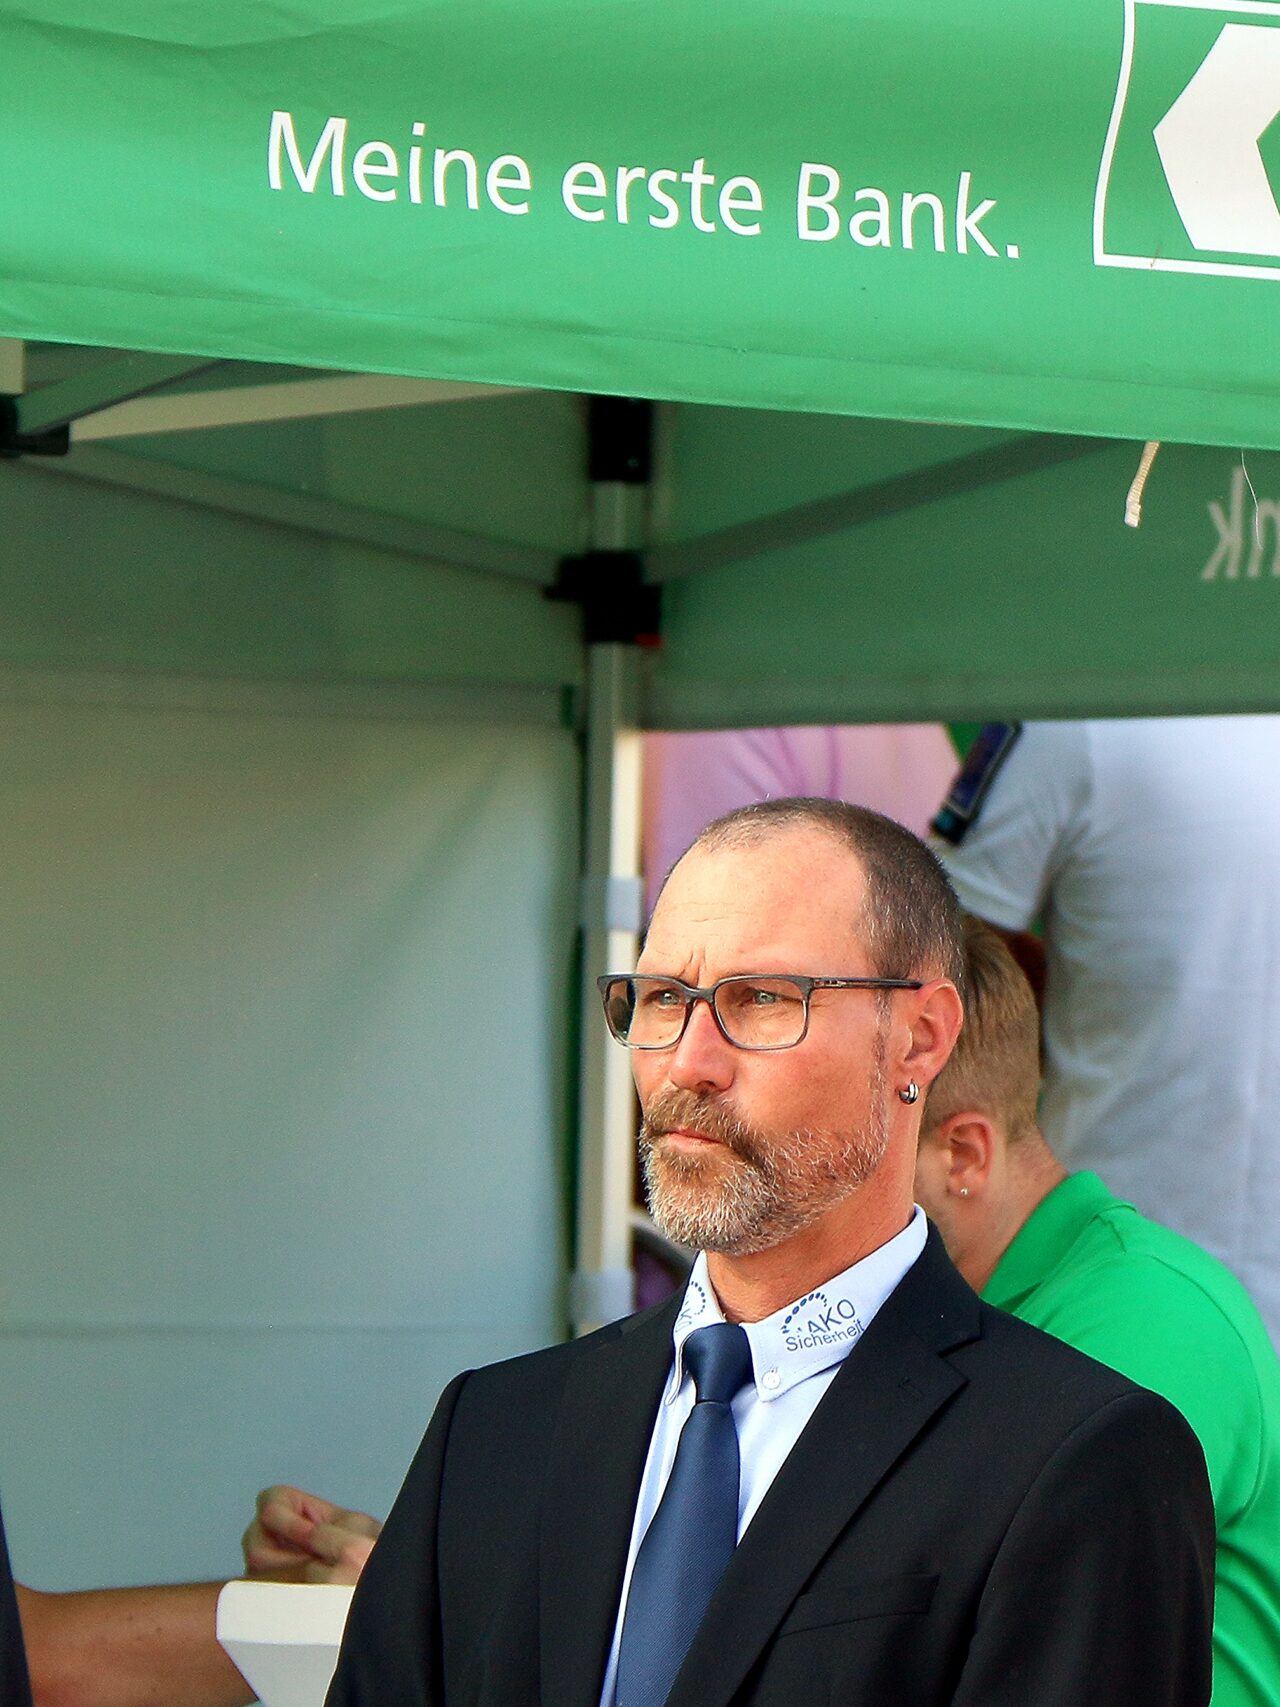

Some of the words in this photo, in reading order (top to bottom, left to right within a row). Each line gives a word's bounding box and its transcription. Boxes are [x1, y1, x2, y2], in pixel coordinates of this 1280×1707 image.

[267, 110, 532, 216] Meine
[561, 158, 763, 236] erste
[796, 161, 1021, 260] Bank.
[807, 1298, 856, 1333] AKO
[785, 1318, 865, 1352] Sicherheit
